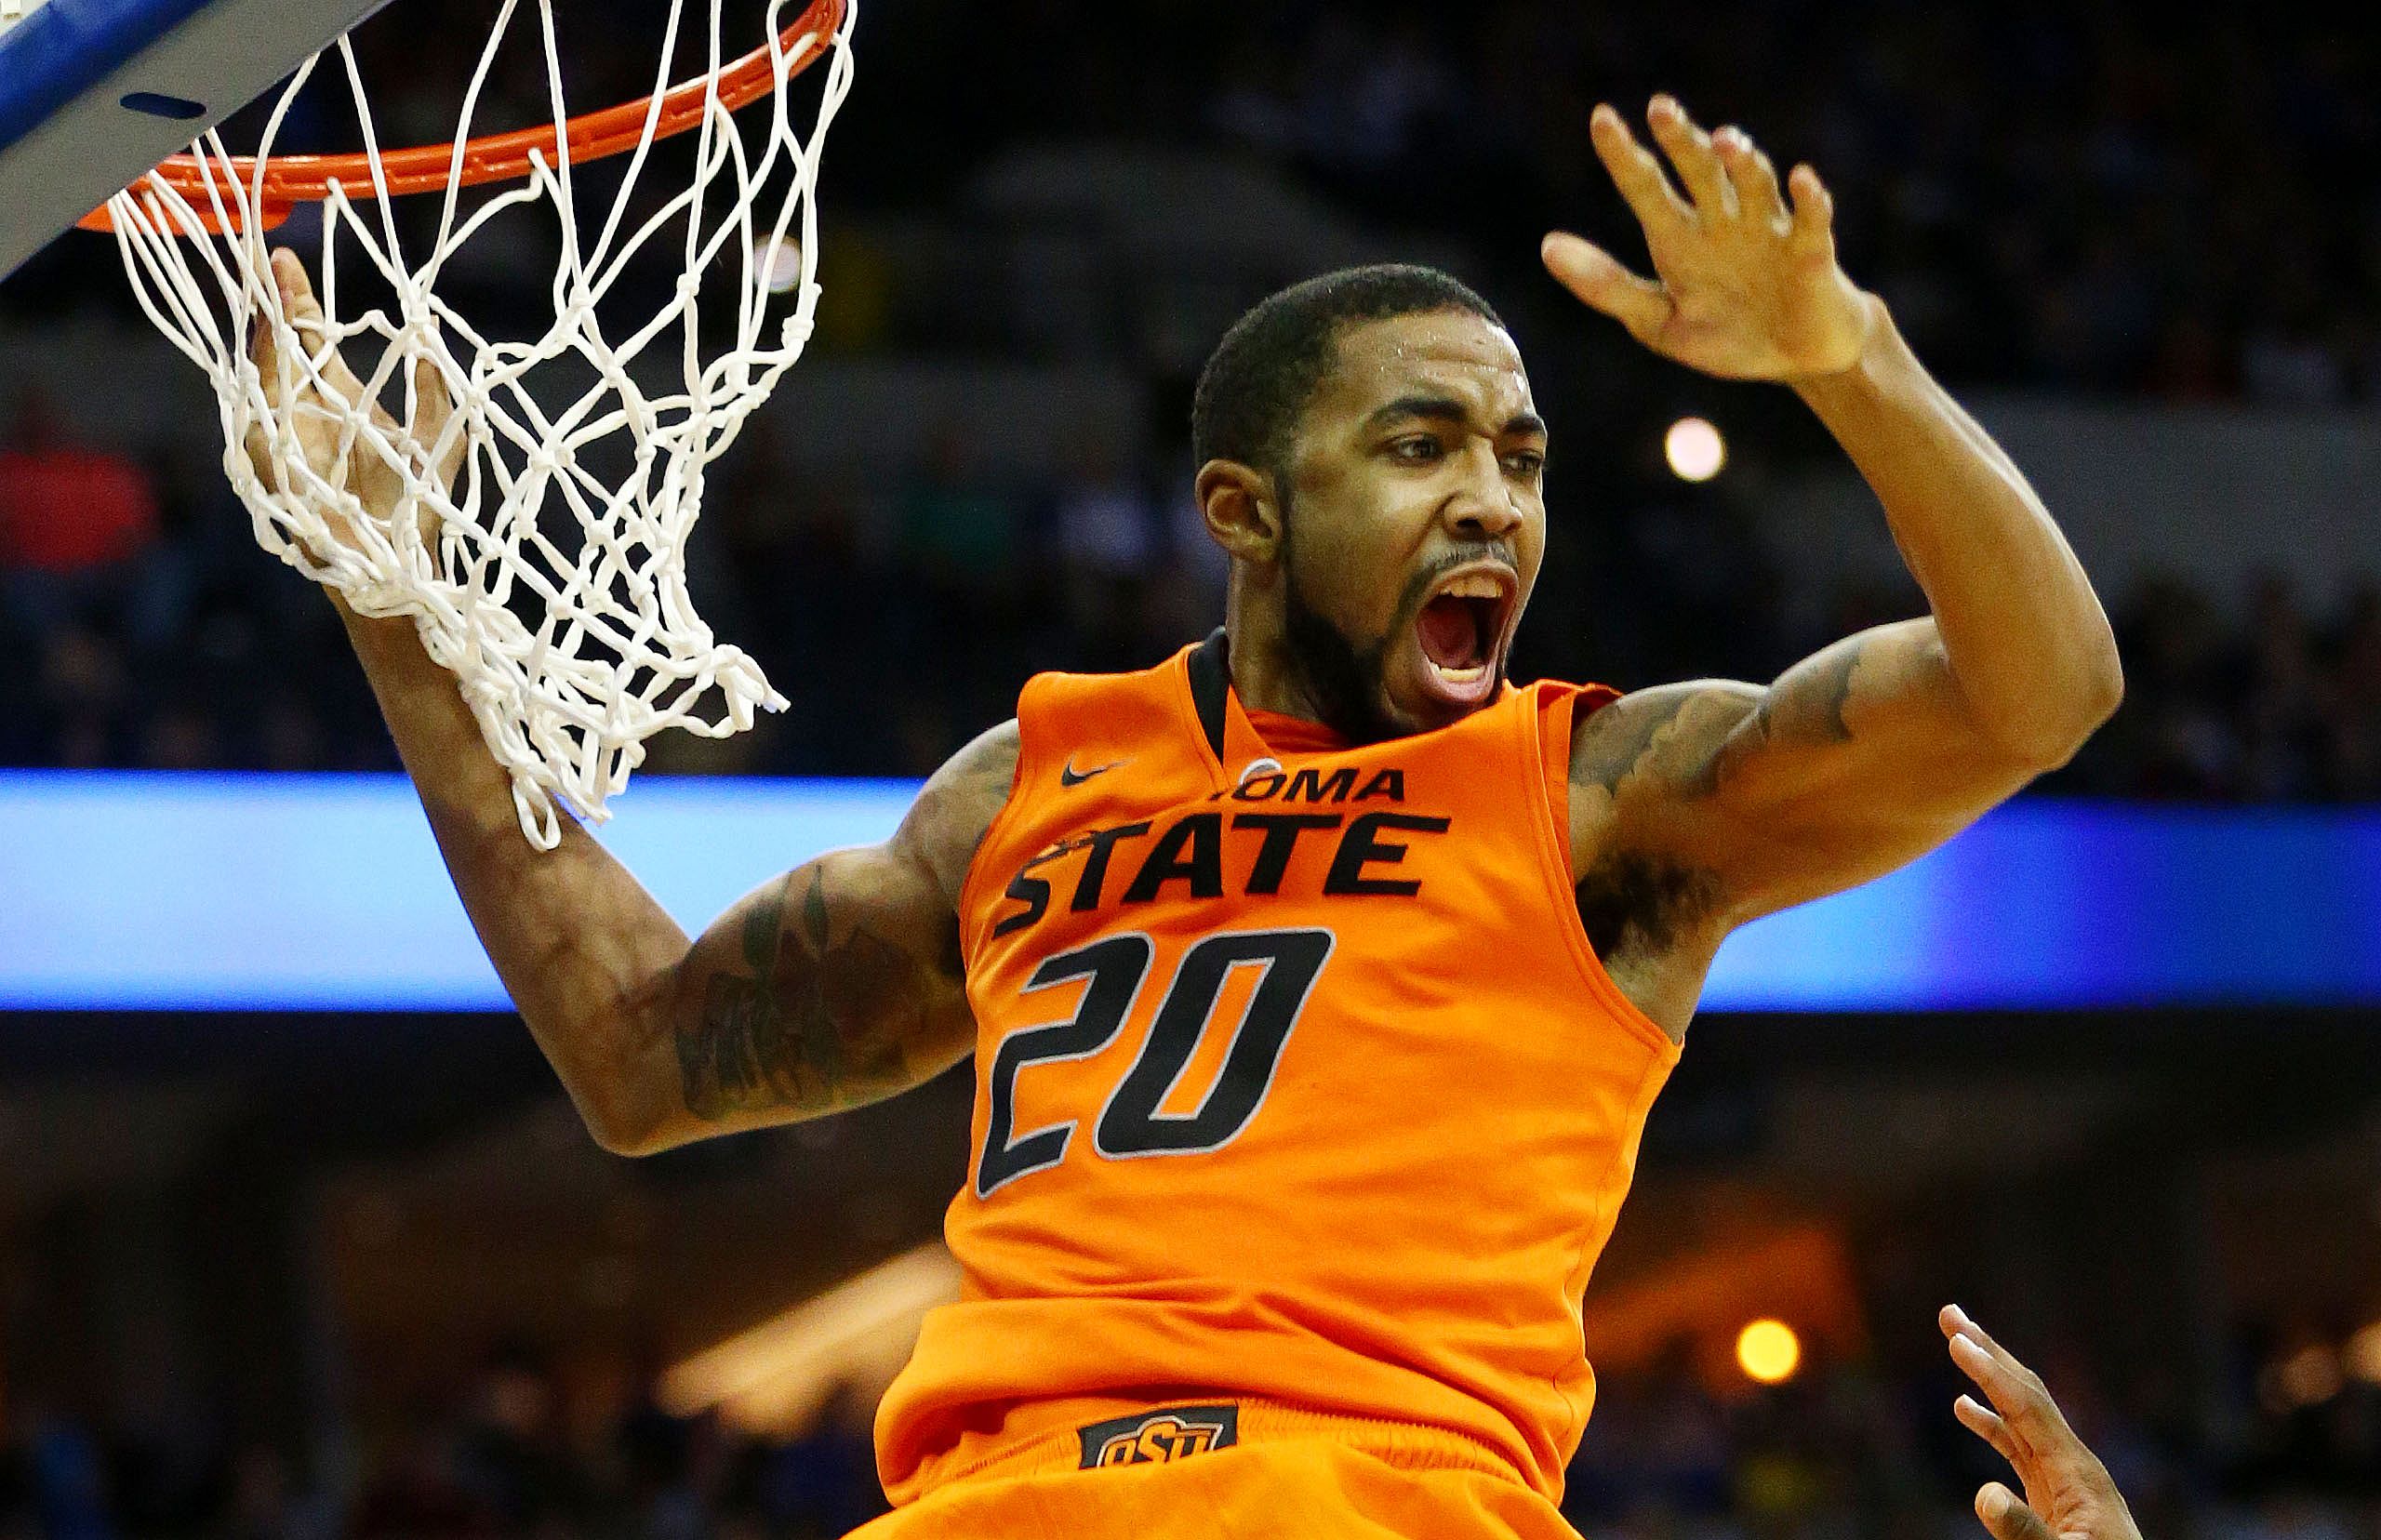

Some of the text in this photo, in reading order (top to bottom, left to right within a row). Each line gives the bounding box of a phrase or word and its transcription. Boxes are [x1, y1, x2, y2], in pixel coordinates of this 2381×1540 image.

[1211, 768, 1405, 803] OMA
[992, 812, 1452, 939] STATE
[976, 926, 1337, 1200] 20
